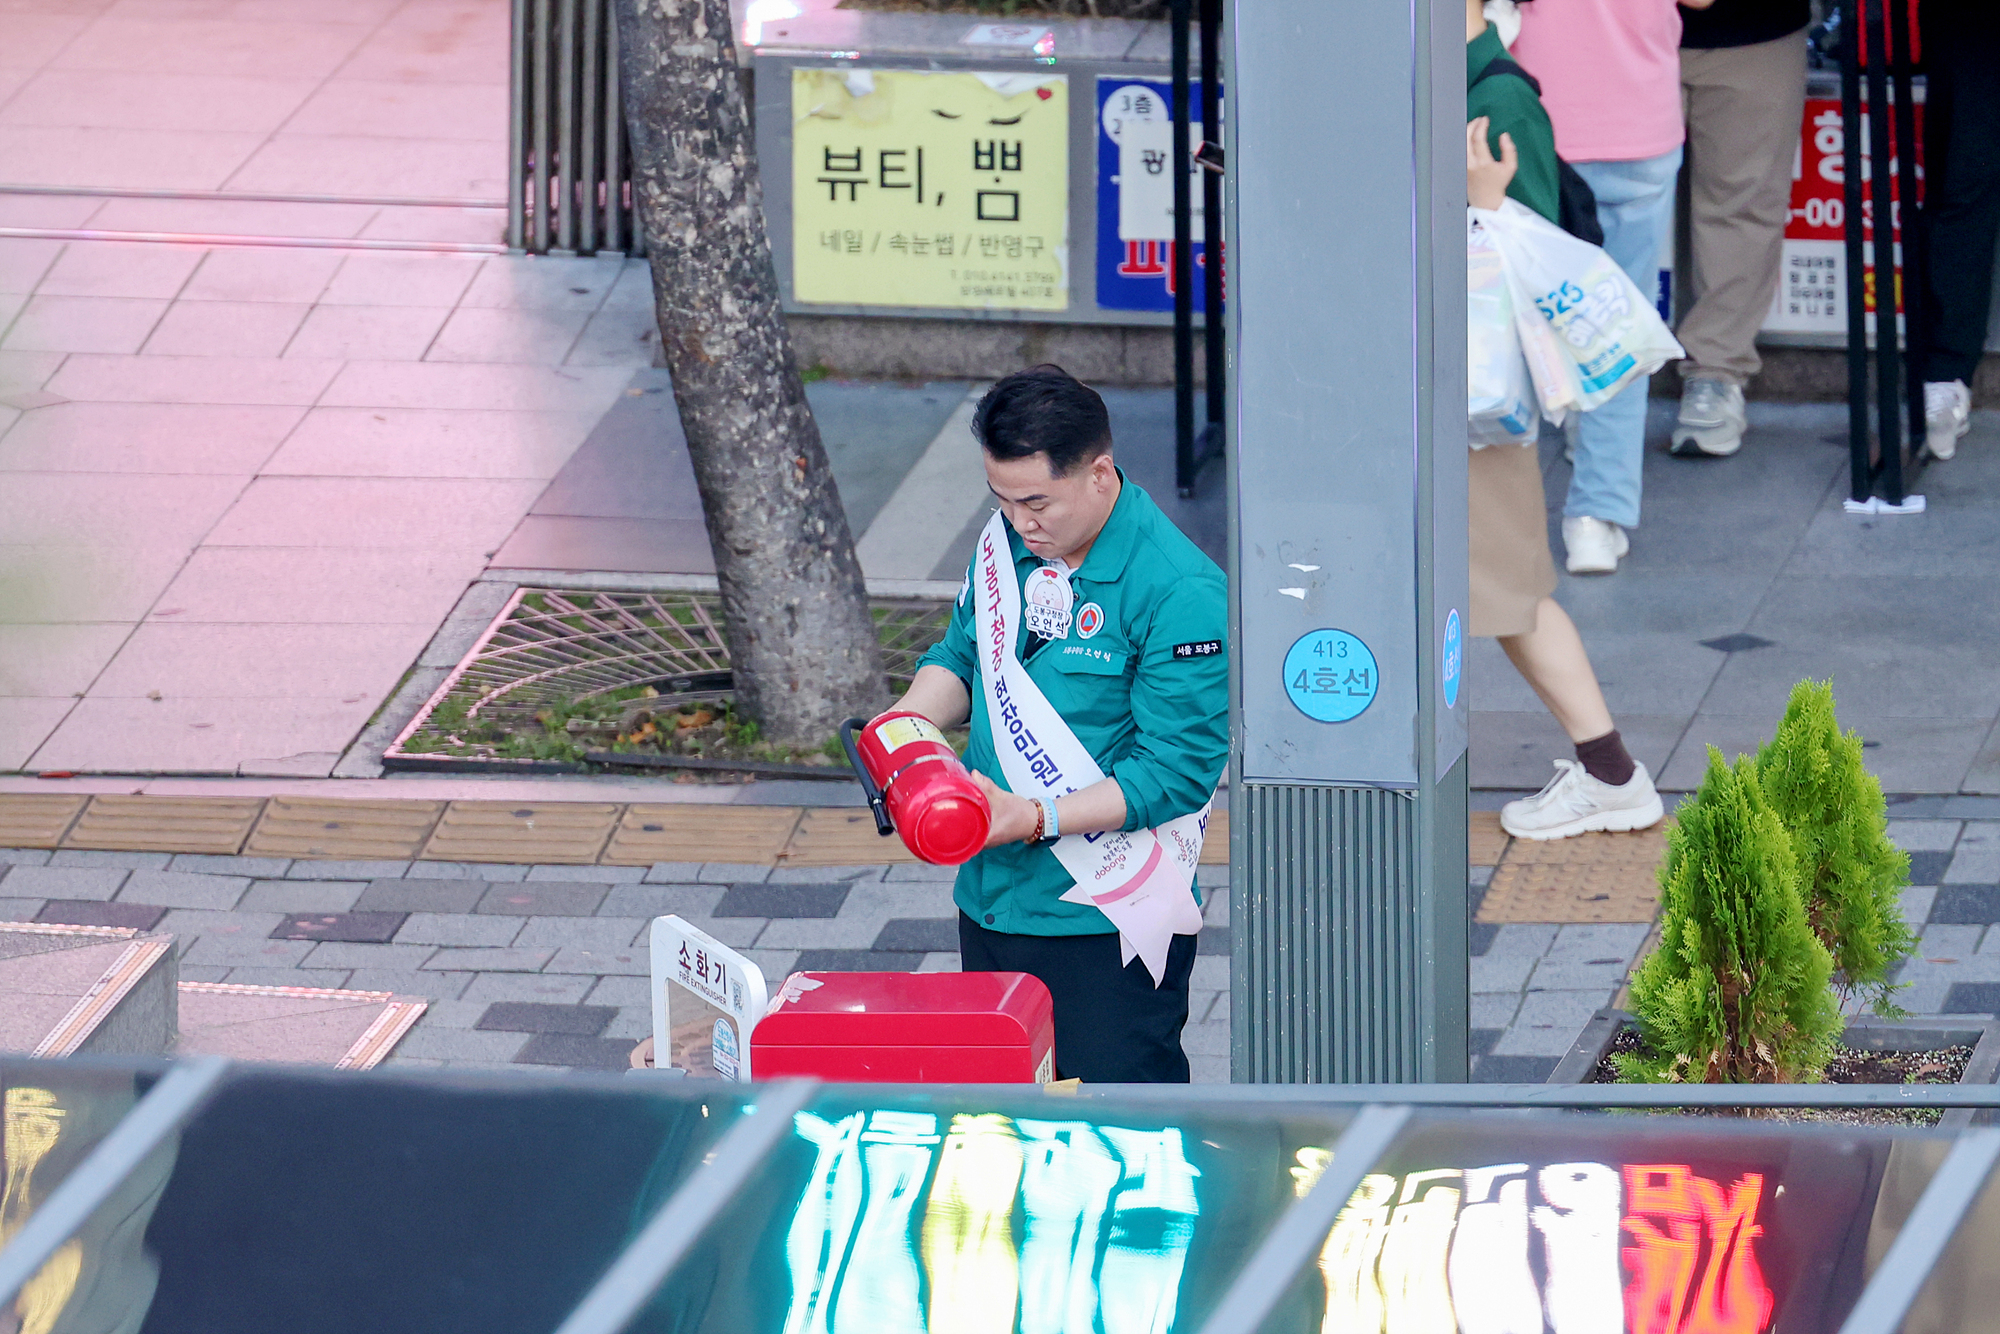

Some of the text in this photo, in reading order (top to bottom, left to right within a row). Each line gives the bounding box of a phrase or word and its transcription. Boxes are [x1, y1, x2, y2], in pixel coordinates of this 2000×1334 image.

[817, 145, 945, 208] 뷰티,
[819, 229, 863, 254] 네일
[889, 231, 955, 256] 속눈썹
[978, 234, 1045, 259] 반영구
[1030, 615, 1065, 635] 오언석
[1176, 642, 1219, 656] 서울 도봉구
[1312, 639, 1348, 658] 413
[1292, 666, 1370, 697] 4호선
[1094, 853, 1127, 880] dobong
[678, 940, 727, 995] 소화기
[678, 970, 727, 1006] FIRE EXTINGUISHER
